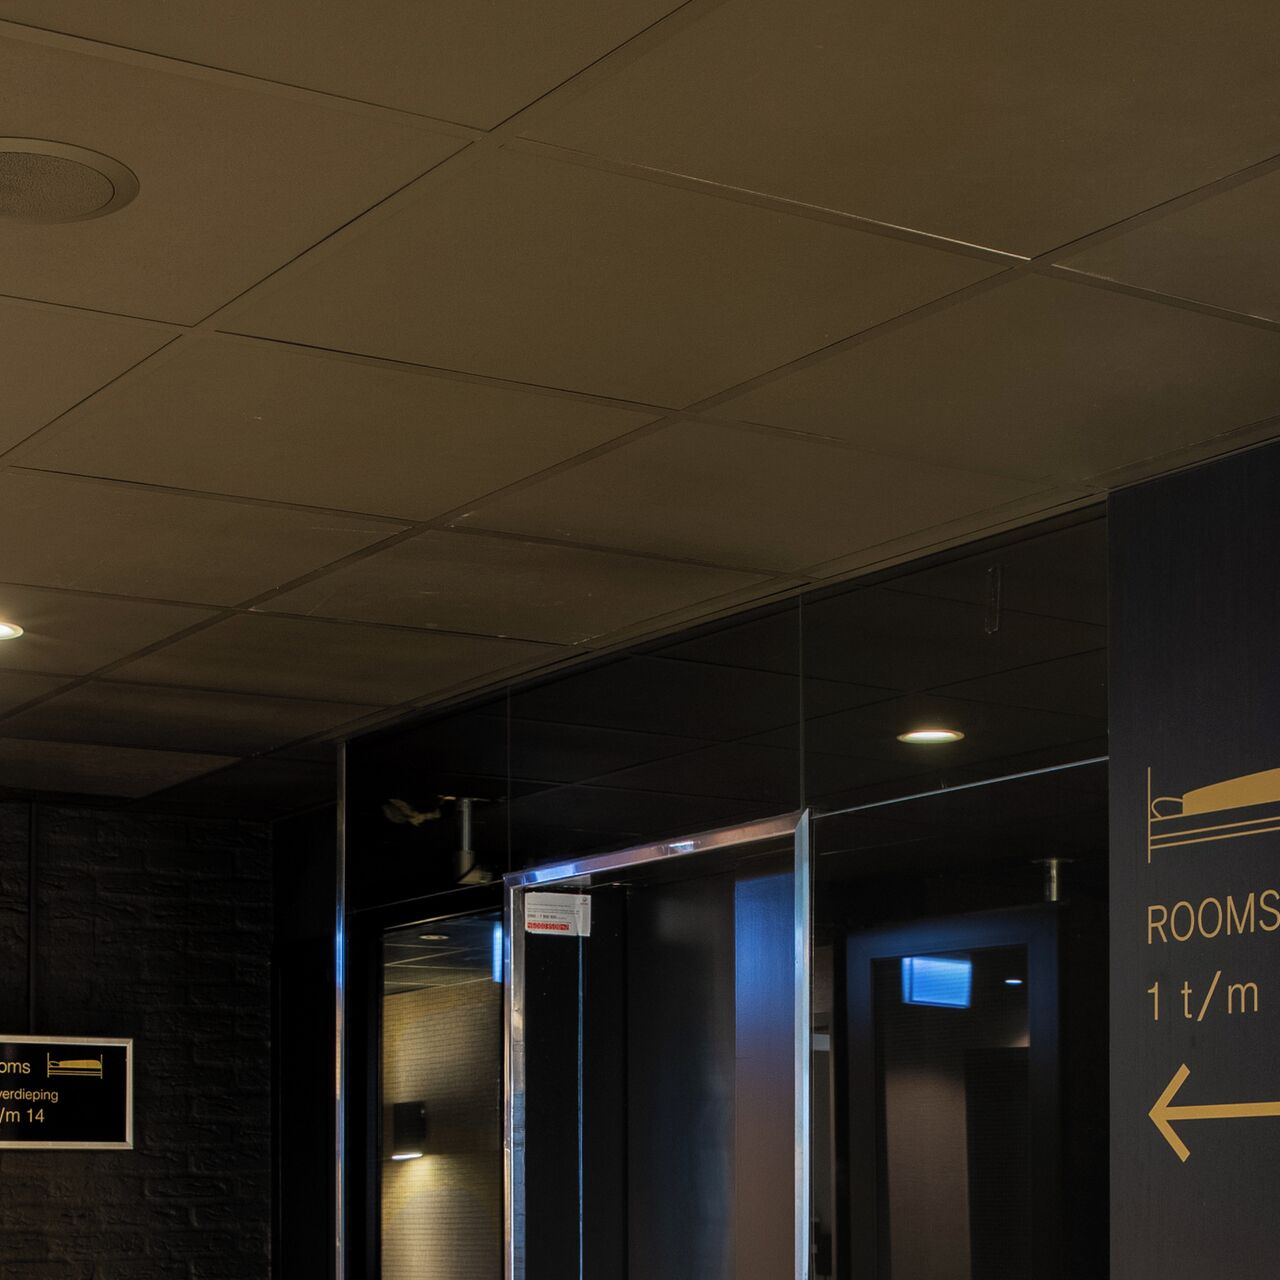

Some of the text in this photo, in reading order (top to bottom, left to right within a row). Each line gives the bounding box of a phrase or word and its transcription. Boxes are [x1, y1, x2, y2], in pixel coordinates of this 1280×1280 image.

[1147, 980, 1161, 1021] 1
[1181, 970, 1260, 1022] t/m
[27, 1108, 45, 1123] 14
